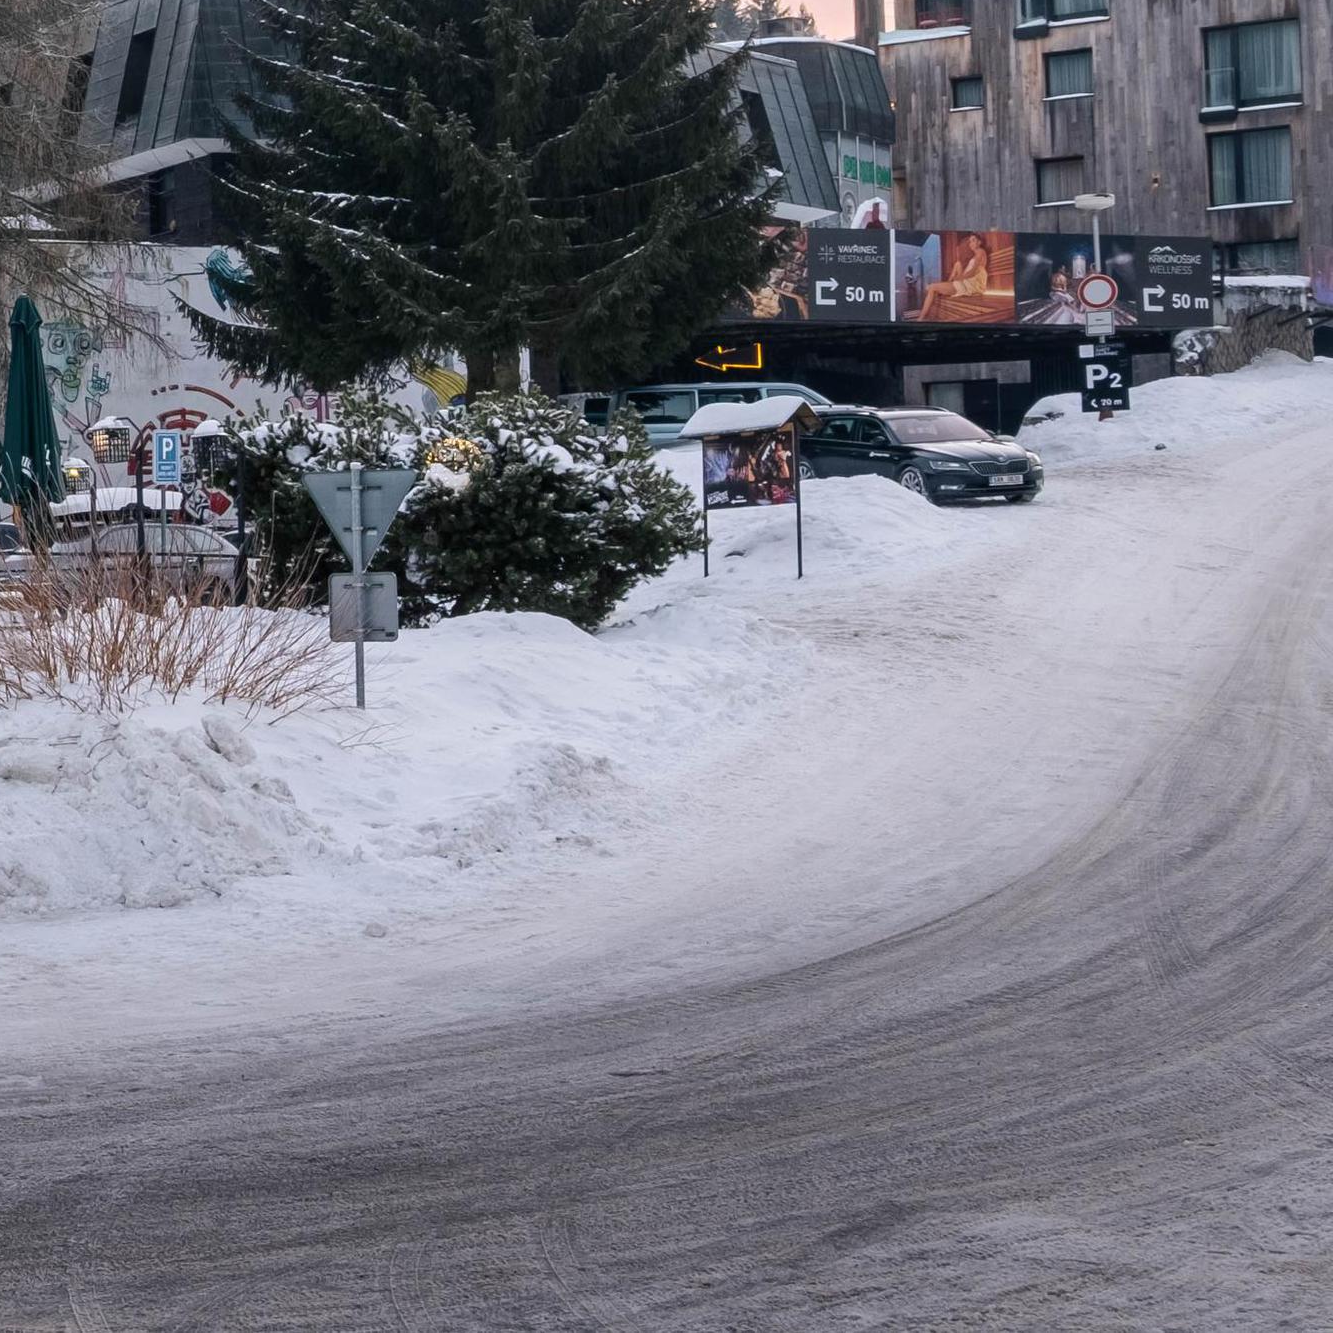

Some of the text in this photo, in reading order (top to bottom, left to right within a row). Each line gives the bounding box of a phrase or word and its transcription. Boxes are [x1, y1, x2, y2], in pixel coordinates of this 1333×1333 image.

[845, 287, 884, 302] 50 m
[1172, 293, 1209, 309] 50 m
[163, 438, 173, 460] P
